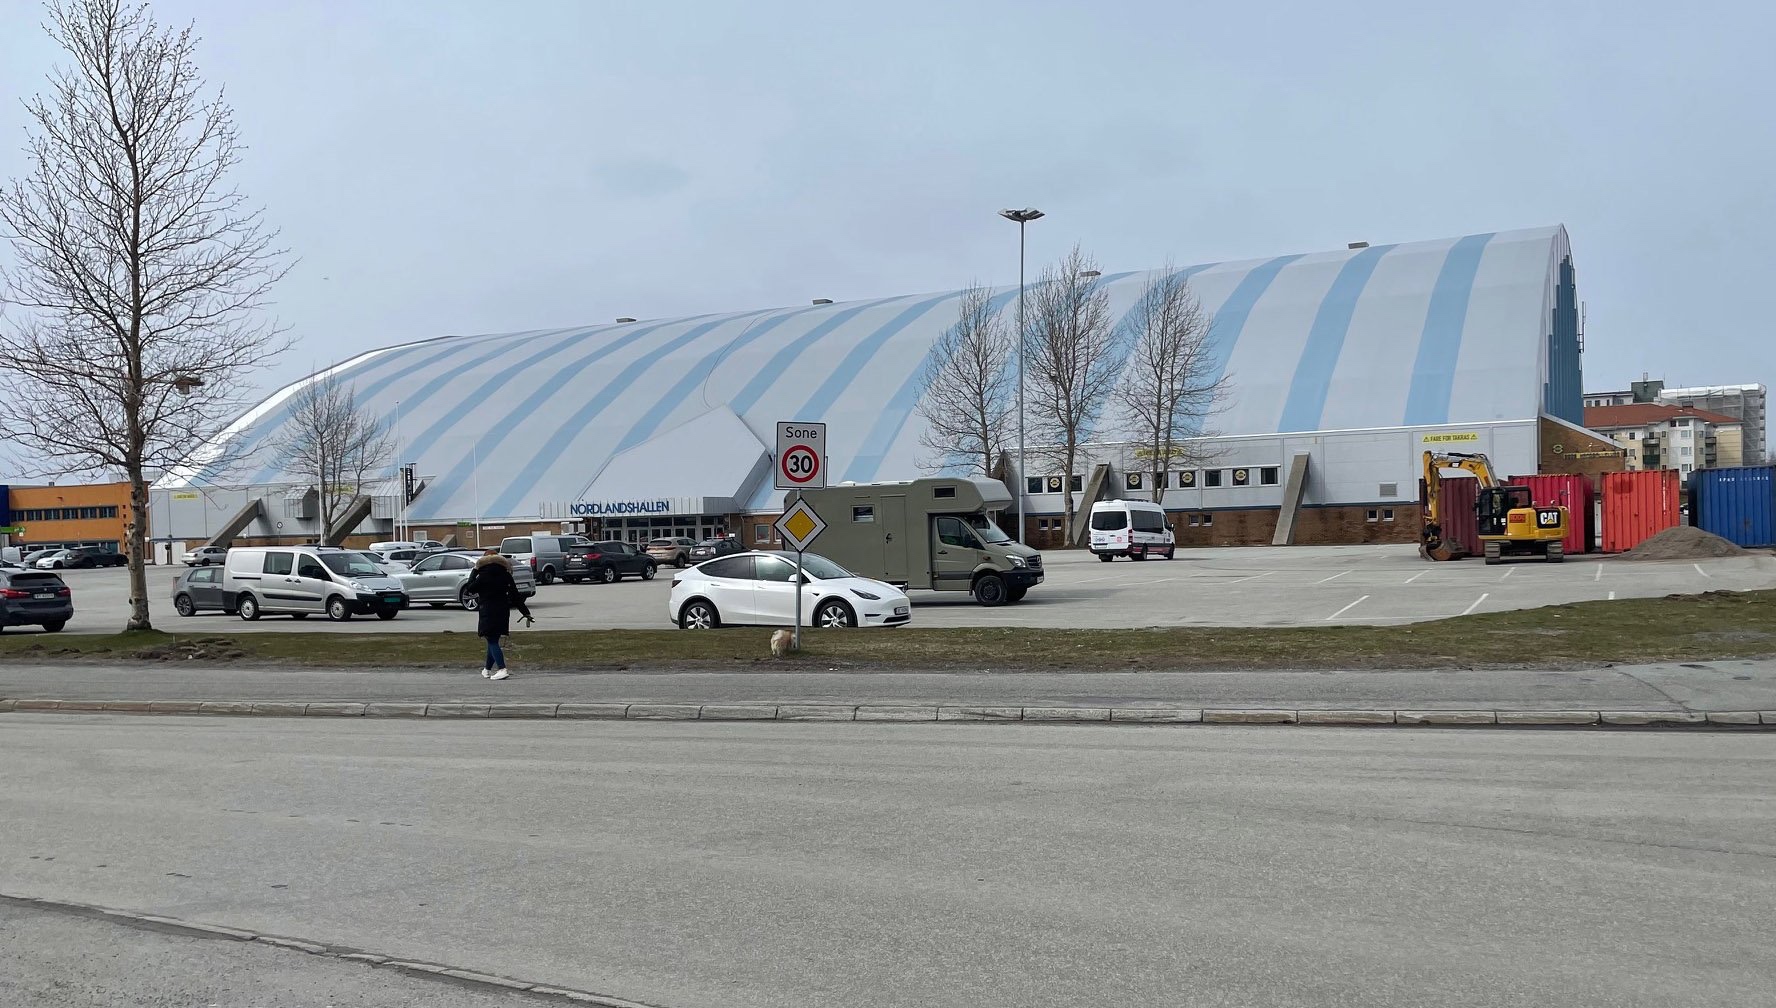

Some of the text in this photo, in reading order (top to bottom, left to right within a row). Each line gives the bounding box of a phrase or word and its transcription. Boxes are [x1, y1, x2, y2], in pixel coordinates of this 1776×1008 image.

[785, 426, 817, 439] Sone
[789, 454, 813, 474] 30
[570, 501, 669, 515] NORDLANDSHALLEN
[1540, 512, 1558, 525] CAT
